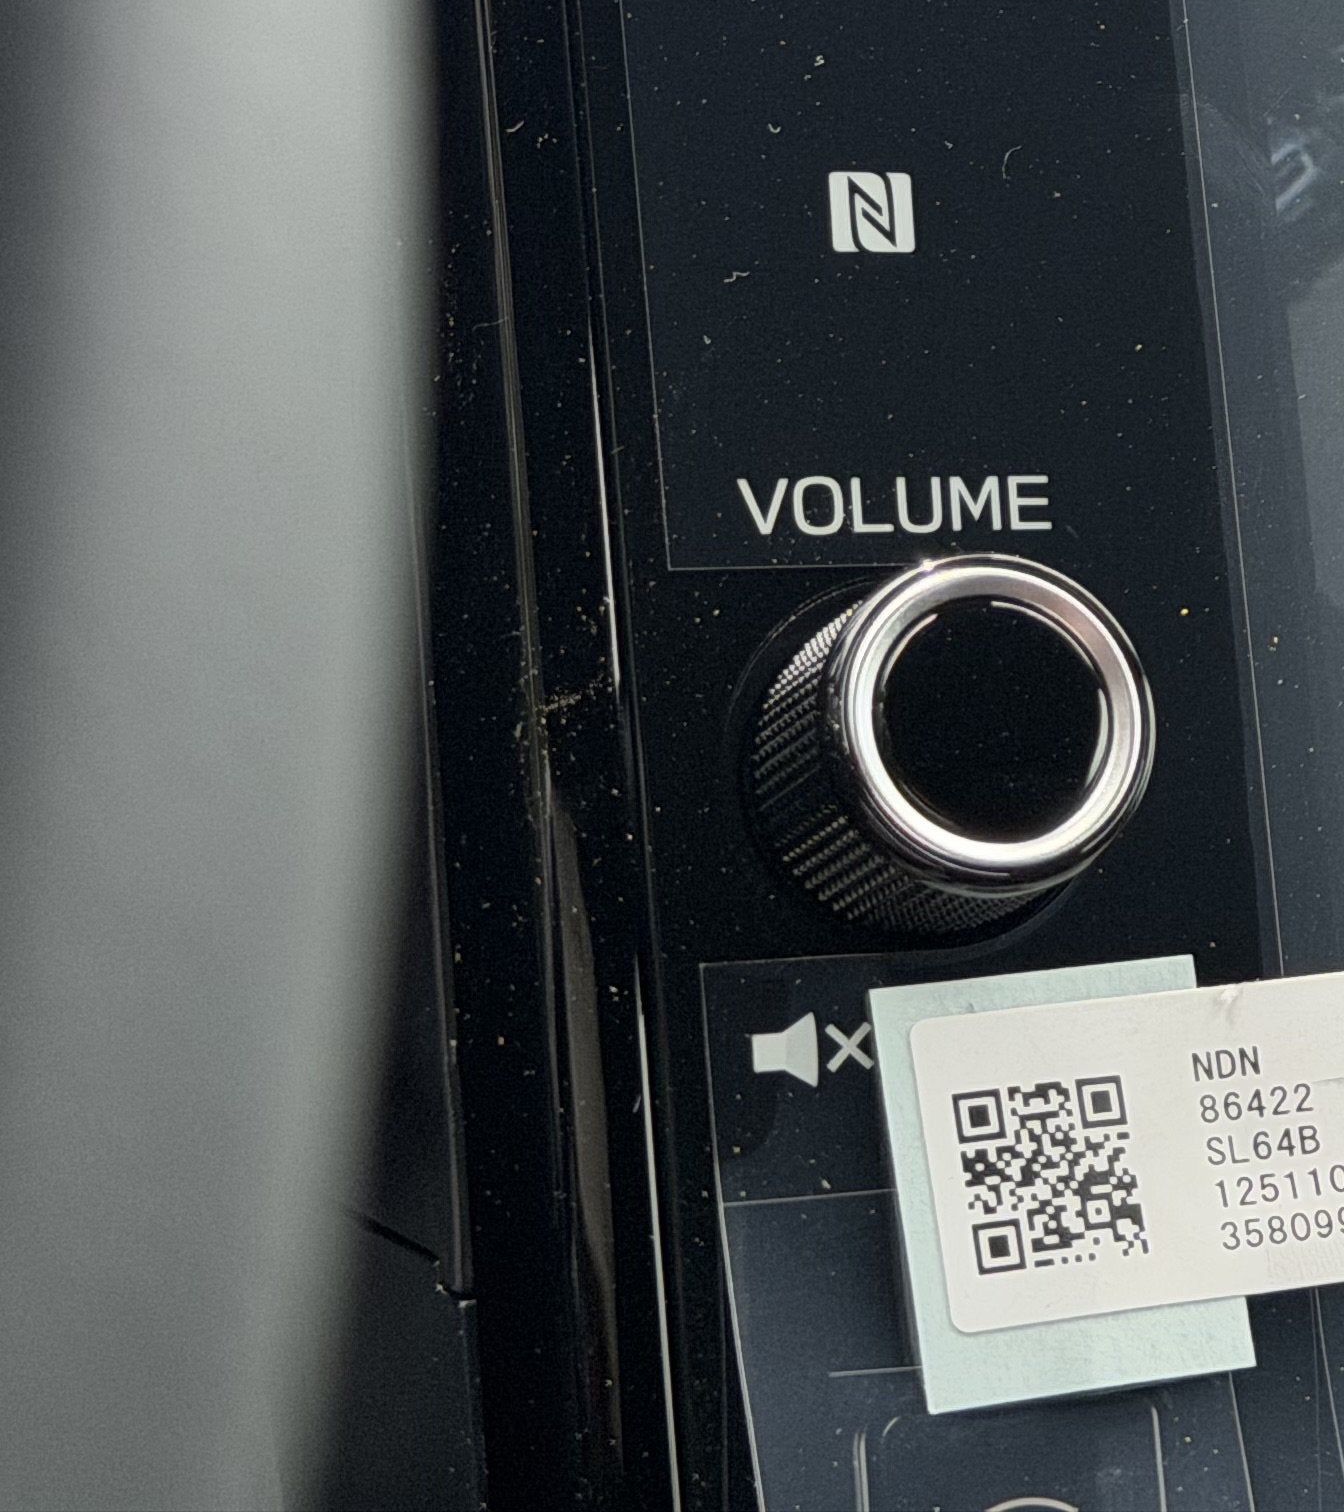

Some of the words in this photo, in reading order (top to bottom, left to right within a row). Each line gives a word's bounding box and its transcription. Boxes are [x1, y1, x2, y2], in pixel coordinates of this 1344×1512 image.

[736, 475, 1053, 535] VOLUME
[1191, 1045, 1261, 1082] NDN
[1199, 1082, 1315, 1123] 86422
[1206, 1125, 1321, 1166] SL64B
